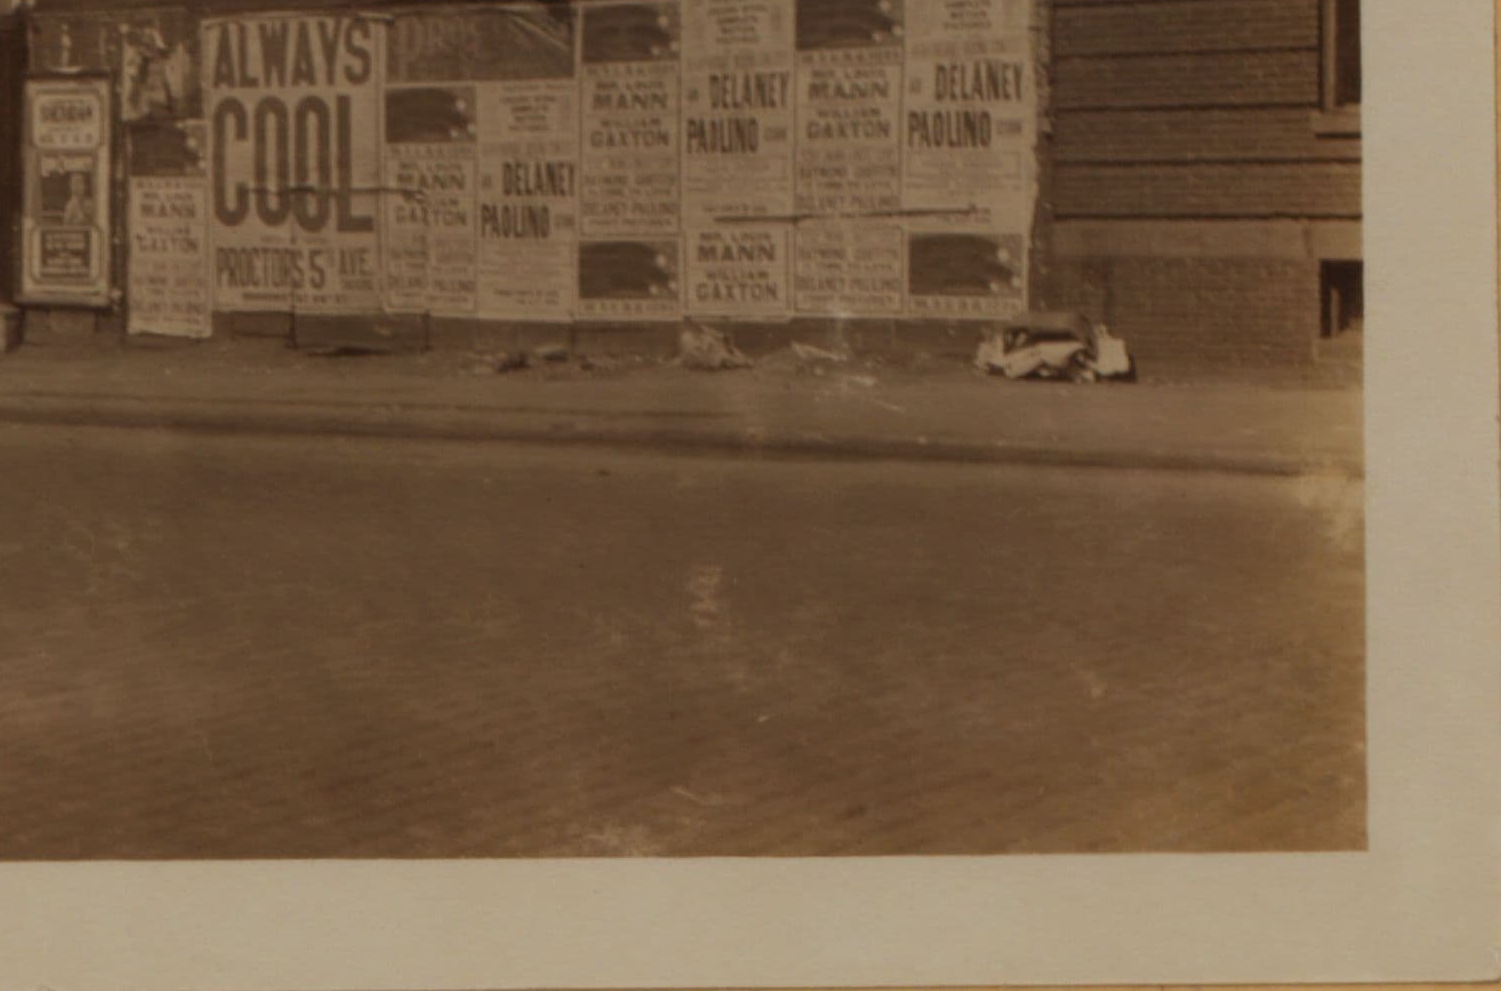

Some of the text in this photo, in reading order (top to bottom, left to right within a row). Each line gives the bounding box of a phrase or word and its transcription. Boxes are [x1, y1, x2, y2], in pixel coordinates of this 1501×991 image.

[212, 19, 372, 89] ALWAYS
[709, 72, 788, 110] DELANEY
[809, 81, 890, 100] MANN
[935, 60, 1023, 102] DELANEY
[592, 93, 668, 110] MANN
[590, 129, 670, 148] GAXTON
[685, 117, 759, 154] PAOLINO
[806, 119, 891, 140] GAXTON
[908, 110, 992, 148] PAOLINO
[213, 94, 374, 232] COOL
[396, 173, 466, 190] MANN
[502, 161, 574, 197] DELANEY
[395, 205, 468, 227] GAXTON
[481, 203, 549, 239] PAOLINO
[698, 244, 776, 262] MANN
[696, 281, 778, 303] GAXTON
